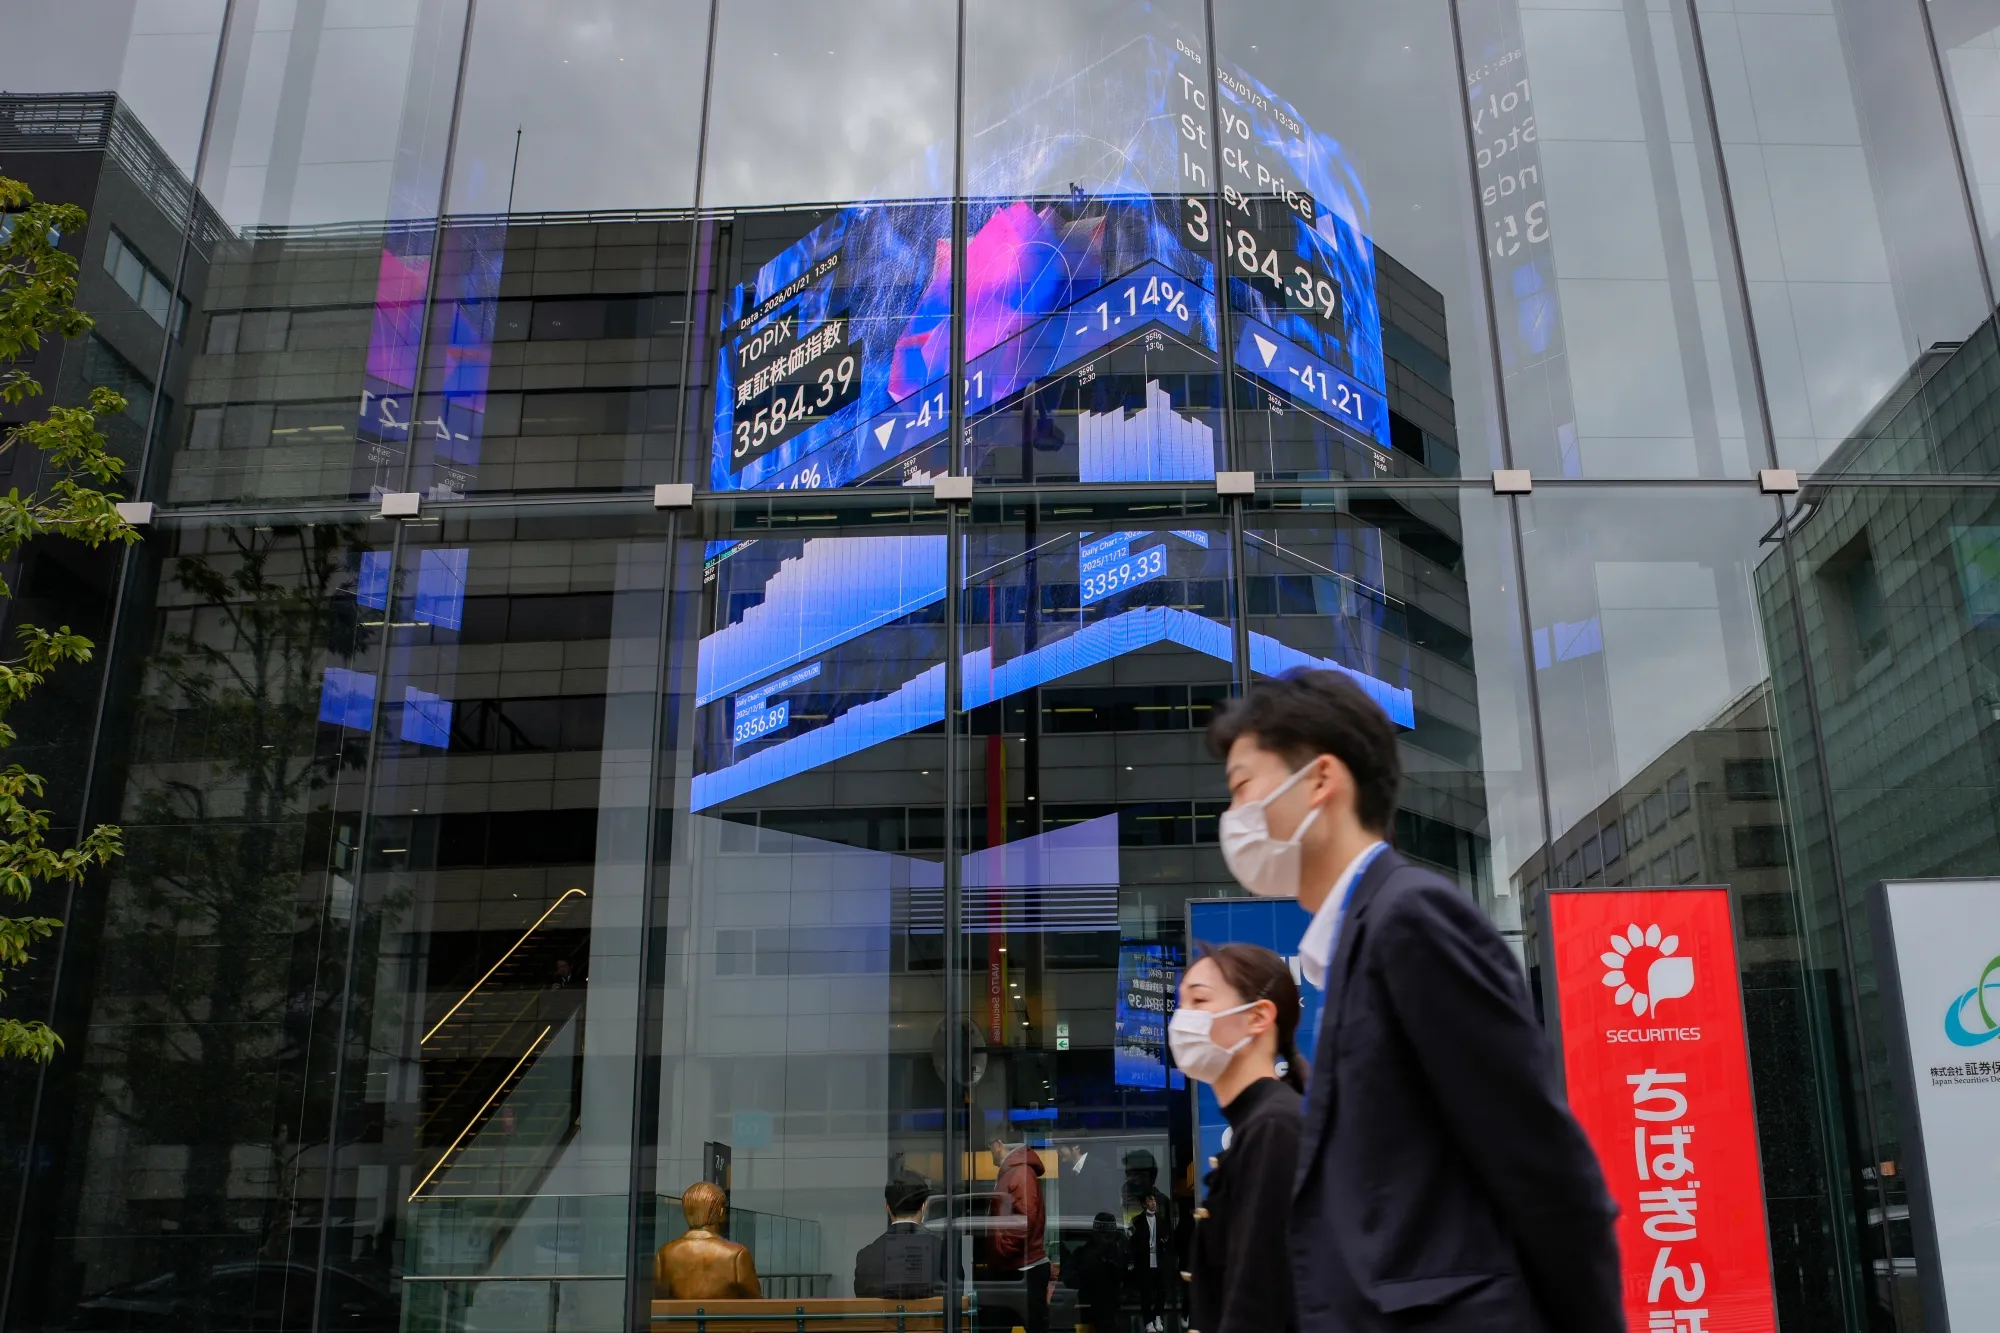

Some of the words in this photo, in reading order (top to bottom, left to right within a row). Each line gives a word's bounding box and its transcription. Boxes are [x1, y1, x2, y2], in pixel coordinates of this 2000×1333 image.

[1176, 38, 1202, 64] Data
[1217, 68, 1267, 112] 026/01/21
[1273, 108, 1300, 135] 13:30
[1178, 72, 1249, 140] Toyo
[1181, 114, 1251, 179] Stck
[1257, 163, 1312, 219] Price
[1184, 152, 1250, 216] Inex
[740, 313, 759, 330] Data
[764, 275, 810, 313] 2026/01/21
[815, 255, 838, 278] 13:30
[740, 315, 792, 368] TOPIX
[1145, 341, 1164, 352] 13:00
[735, 321, 843, 410] 東証株価指数
[1078, 364, 1094, 377] 3590
[1079, 372, 1096, 386] 12:30
[733, 356, 855, 458] 3584.39
[1288, 365, 1363, 421] -41.21
[903, 457, 917, 470] 3597
[903, 465, 918, 477] 11:00
[1082, 546, 1098, 558] Daily
[1100, 537, 1118, 551] Chart
[1082, 547, 1127, 572] 2025/11/12
[1083, 551, 1161, 600] 3359.33
[735, 706, 785, 742] 3356.89
[1606, 1027, 1701, 1043] SECURITIES
[1931, 1078, 1953, 1086] Japan
[1953, 1075, 1989, 1085] Securities
